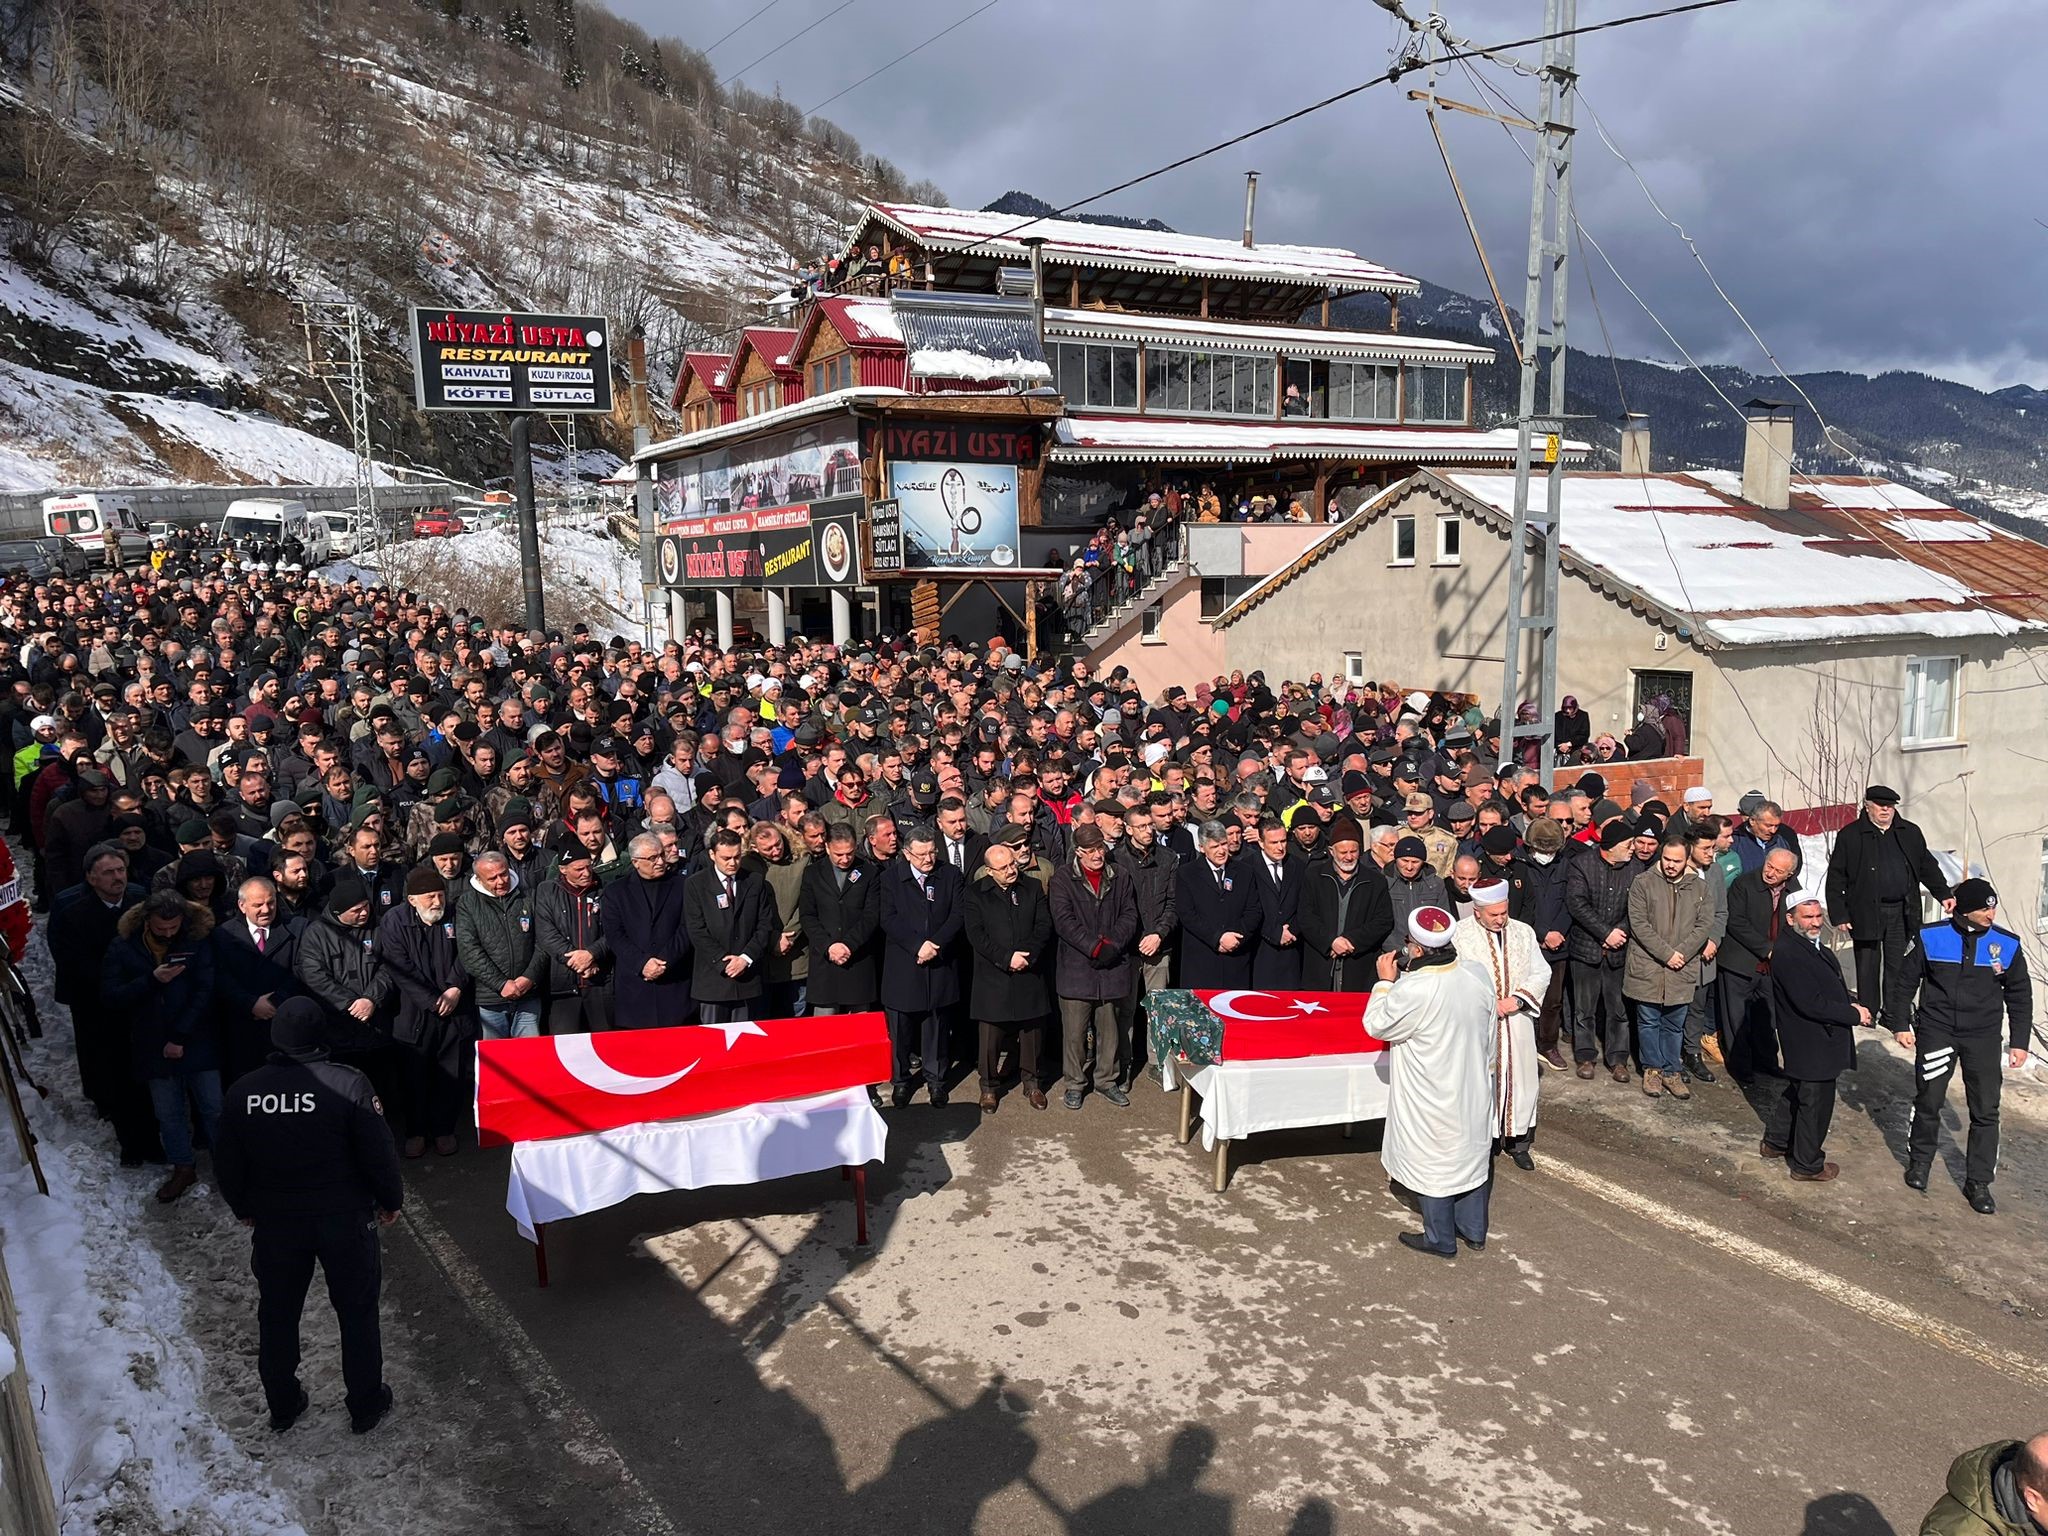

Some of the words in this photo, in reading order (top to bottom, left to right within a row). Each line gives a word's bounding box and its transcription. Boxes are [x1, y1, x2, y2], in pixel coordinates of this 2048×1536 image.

[427, 312, 515, 344] NİYAZİ
[521, 325, 585, 347] USTA
[440, 348, 591, 364] RESTAURANT
[445, 367, 509, 379] KAHVALTI
[531, 370, 554, 380] KUZU
[447, 387, 511, 399] KÖFTE
[533, 390, 592, 402] SÜTLAÇ
[967, 432, 1033, 460] USTA
[885, 503, 898, 518] USTA
[713, 518, 731, 532] NİYAZİ
[732, 519, 748, 529] USTA
[758, 511, 783, 527] HAMSİKÖY
[784, 510, 808, 524] SÜTLACI
[872, 521, 899, 537] HAMSİKÖY
[875, 538, 897, 553] SÜTLACI
[937, 542, 975, 556] LUX
[686, 539, 725, 578] NİYAZİ
[727, 550, 763, 577] USTA
[764, 540, 811, 578] RESTAURANT
